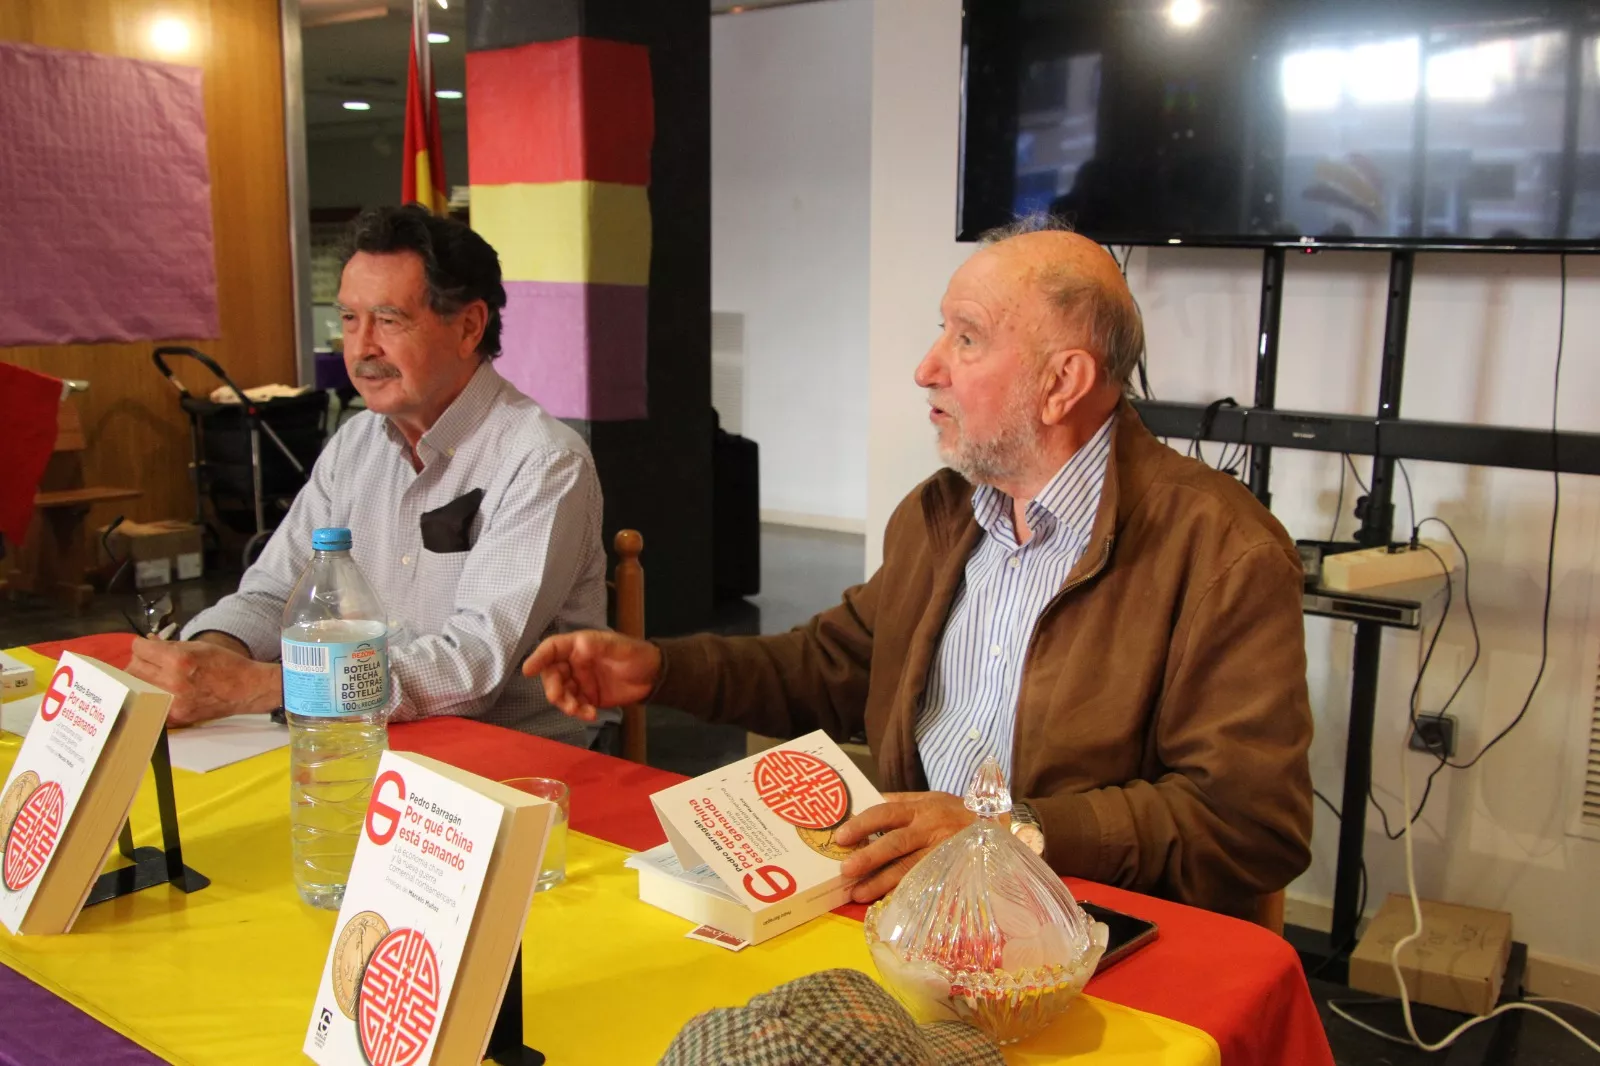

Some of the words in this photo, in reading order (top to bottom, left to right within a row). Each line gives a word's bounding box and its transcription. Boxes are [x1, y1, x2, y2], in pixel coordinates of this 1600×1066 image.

[344, 661, 380, 674] BOTELLA
[349, 670, 378, 682] HECHA
[341, 683, 355, 691] DE
[357, 677, 382, 689] OTRAS
[341, 685, 382, 699] BOTELLAS
[68, 691, 80, 705] Por
[89, 705, 106, 724] China
[72, 715, 97, 737] ganando
[409, 792, 430, 809] Pedro
[430, 802, 462, 826] Barragán
[689, 799, 716, 829] China
[702, 797, 745, 842] ganando
[404, 805, 423, 825] Por
[424, 818, 444, 836] qué
[445, 826, 474, 853] China
[694, 819, 723, 851] Barragán
[714, 829, 735, 850] qué
[399, 827, 422, 847] está
[421, 838, 465, 871] ganando
[733, 850, 753, 869] Por
[740, 842, 764, 864] está
[722, 851, 743, 873] Pedro
